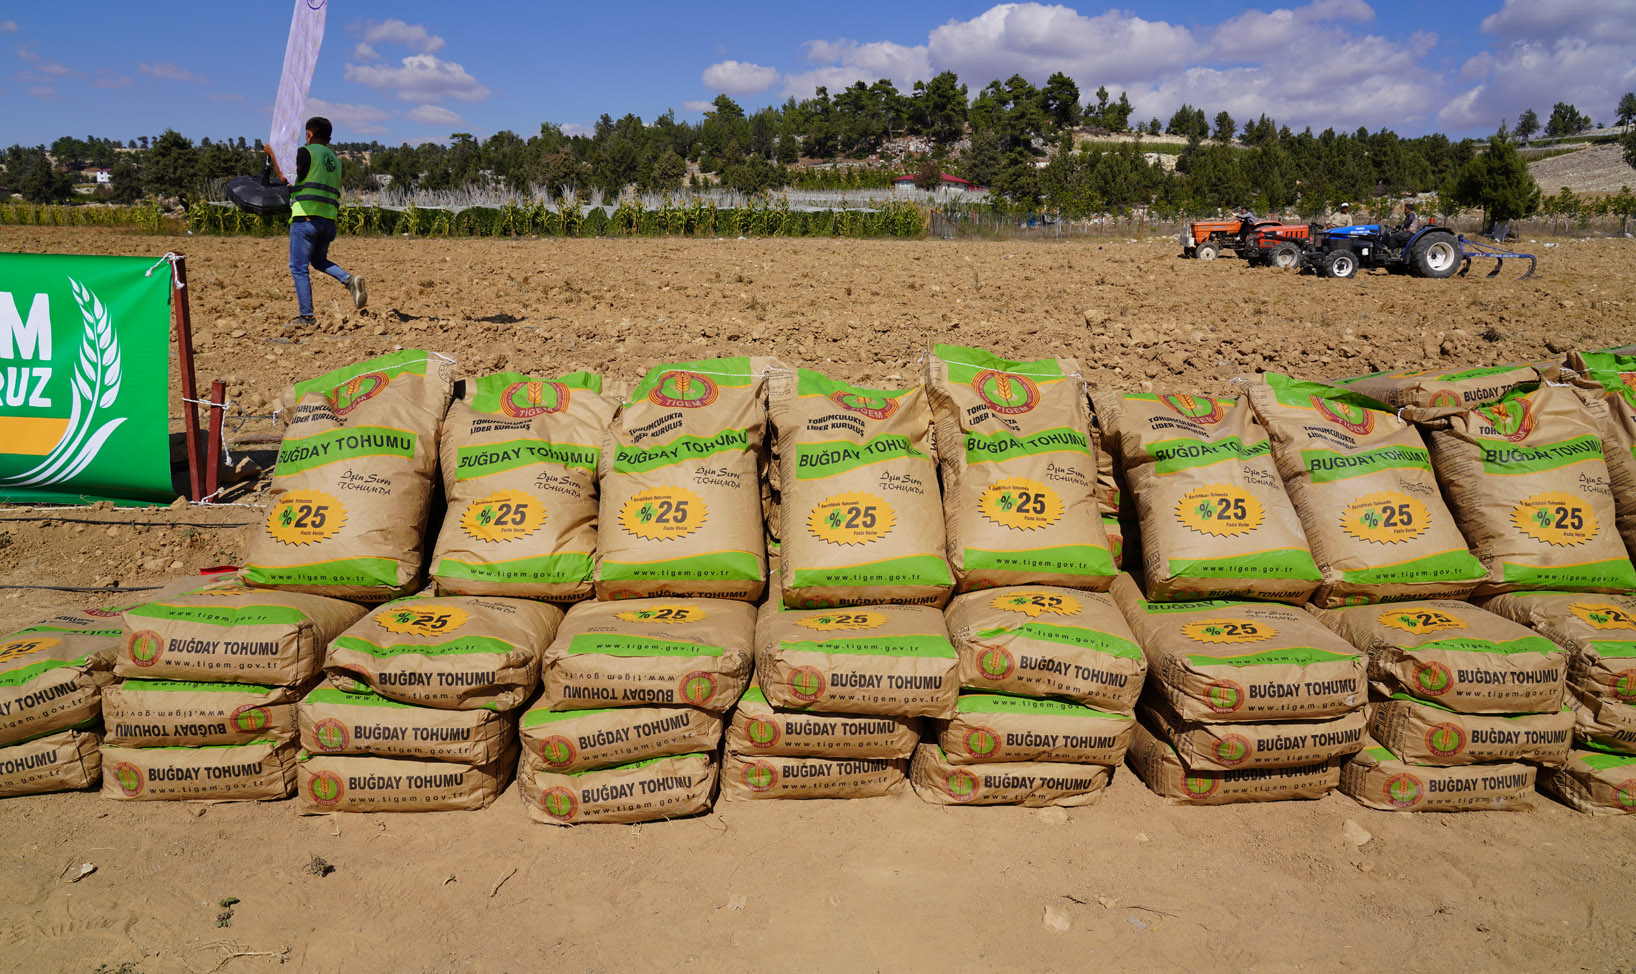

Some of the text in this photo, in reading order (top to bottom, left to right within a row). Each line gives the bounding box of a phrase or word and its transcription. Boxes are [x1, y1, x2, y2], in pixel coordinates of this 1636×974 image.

[0, 366, 52, 407] UZ
[628, 412, 683, 436] TOHUMCULUKTA
[808, 414, 866, 428] TOHUMCULUKTA
[969, 413, 989, 426] LİDER
[470, 424, 491, 434] LİDER
[831, 423, 864, 438] KURULUŞ
[279, 435, 410, 464] BUĞDAY TOHUMU
[616, 432, 748, 464] BUĞDAY TOHUMU
[967, 433, 1087, 454] BUĞDAY TOHUMU
[458, 447, 595, 467] BUĞDAY TOHUMU
[799, 450, 861, 467] BUĞDAY
[1156, 445, 1218, 462] BUĞDAY
[996, 558, 1087, 569] www.tigem.gov.tr
[1202, 565, 1293, 574] www.tigem.gov.tr
[271, 574, 364, 582] www.tigem.gov.tr
[470, 568, 566, 578] www.tigem.gov.tr
[633, 570, 729, 578] www.tigem.gov.tr
[826, 574, 921, 582] www.tigem.gov.tr
[1376, 568, 1463, 580] www.tigem.gov.tr
[1537, 574, 1619, 582] www.tigem.gov.tr
[168, 637, 279, 655] BUĞDAY TOHUMU
[596, 643, 700, 653] www.tigem.gov.tr
[817, 642, 919, 652] www.tigem.gov.tr
[165, 659, 278, 670] www.tigem.gov.tr
[1020, 655, 1128, 688] BUĞDAY TOHUMU
[379, 669, 496, 686] BUĞDAY TOHUMU
[831, 671, 942, 690] BUĞDAY TOHUMU
[1457, 667, 1558, 685] BUĞDAY TOHUMU
[15, 681, 77, 708] TOHUMU
[563, 685, 618, 701] TOHUMU
[1017, 675, 1122, 700] www.tigem.gov.tr
[1249, 678, 1357, 699] BUĞDAY TOHUMU
[1456, 689, 1557, 699] www.tigem.gov.tr
[829, 693, 940, 704] www.tigem.gov.tr
[115, 723, 168, 737] TOHUMU
[354, 724, 470, 741] BUĞDAY TOHUMU
[578, 712, 690, 750] BUĞDAY TOHUMU
[785, 719, 896, 736] BUĞDAY TOHUMU
[1471, 727, 1568, 745] BUĞDAY TOHUMU
[582, 732, 692, 761] www.tigem.gov.tr
[785, 740, 895, 748] www.tigem.gov.tr
[1006, 730, 1116, 748] BUĞDAY TOHUMU
[1257, 728, 1362, 752] BUĞDAY TOHUMU
[149, 762, 263, 781] BUĞDAY TOHUMU
[782, 759, 888, 779] BUĞDAY TOHUMU
[149, 781, 263, 793] www.tigem.gov.tr
[349, 773, 464, 790] BUĞDAY TOHUMU
[582, 776, 692, 804] BUĞDAY TOHUMU
[782, 776, 887, 789] www.tigem.gov.tr
[984, 773, 1092, 790] BUĞDAY TOHUMU
[1223, 779, 1328, 794] www.tigem.gov.tr
[1429, 773, 1528, 793] BUĞDAY TOHUMU
[349, 791, 462, 803] www.tigem.gov.tr
[583, 793, 696, 816] www.tigem.gov.tr
